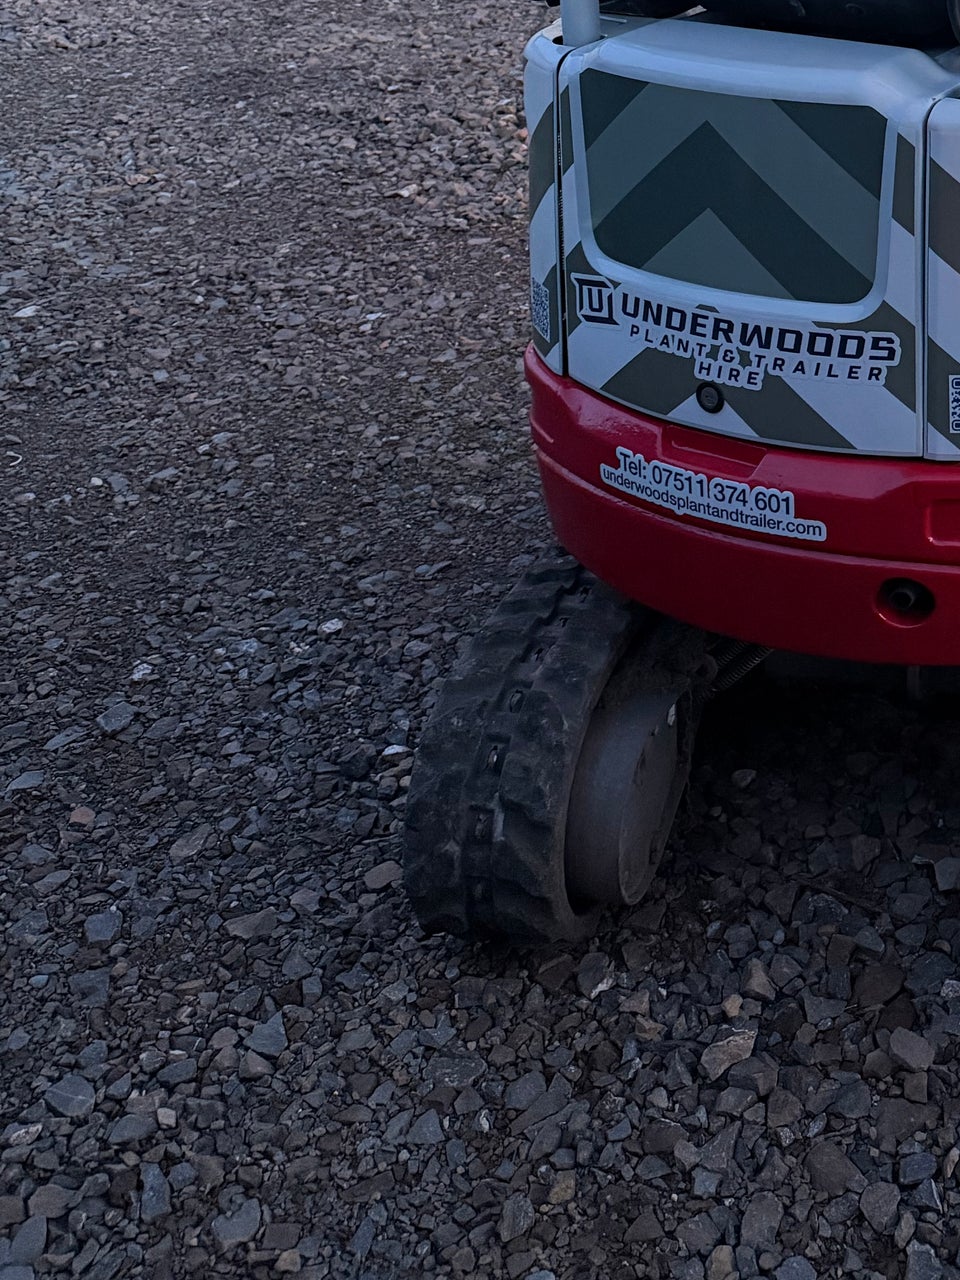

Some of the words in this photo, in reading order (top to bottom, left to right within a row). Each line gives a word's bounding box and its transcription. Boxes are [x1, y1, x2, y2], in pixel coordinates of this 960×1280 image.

[620, 291, 898, 362] UNDERWOODS
[630, 324, 706, 357] PLANT
[722, 349, 736, 363] &
[751, 354, 881, 381] TRAILER
[699, 362, 759, 386] HIRE
[602, 468, 823, 538] underwoodsplantandtrailer.com
[619, 452, 648, 480] Tel:
[652, 464, 706, 498] 07511
[713, 482, 749, 507] 374
[755, 491, 791, 516] 601
